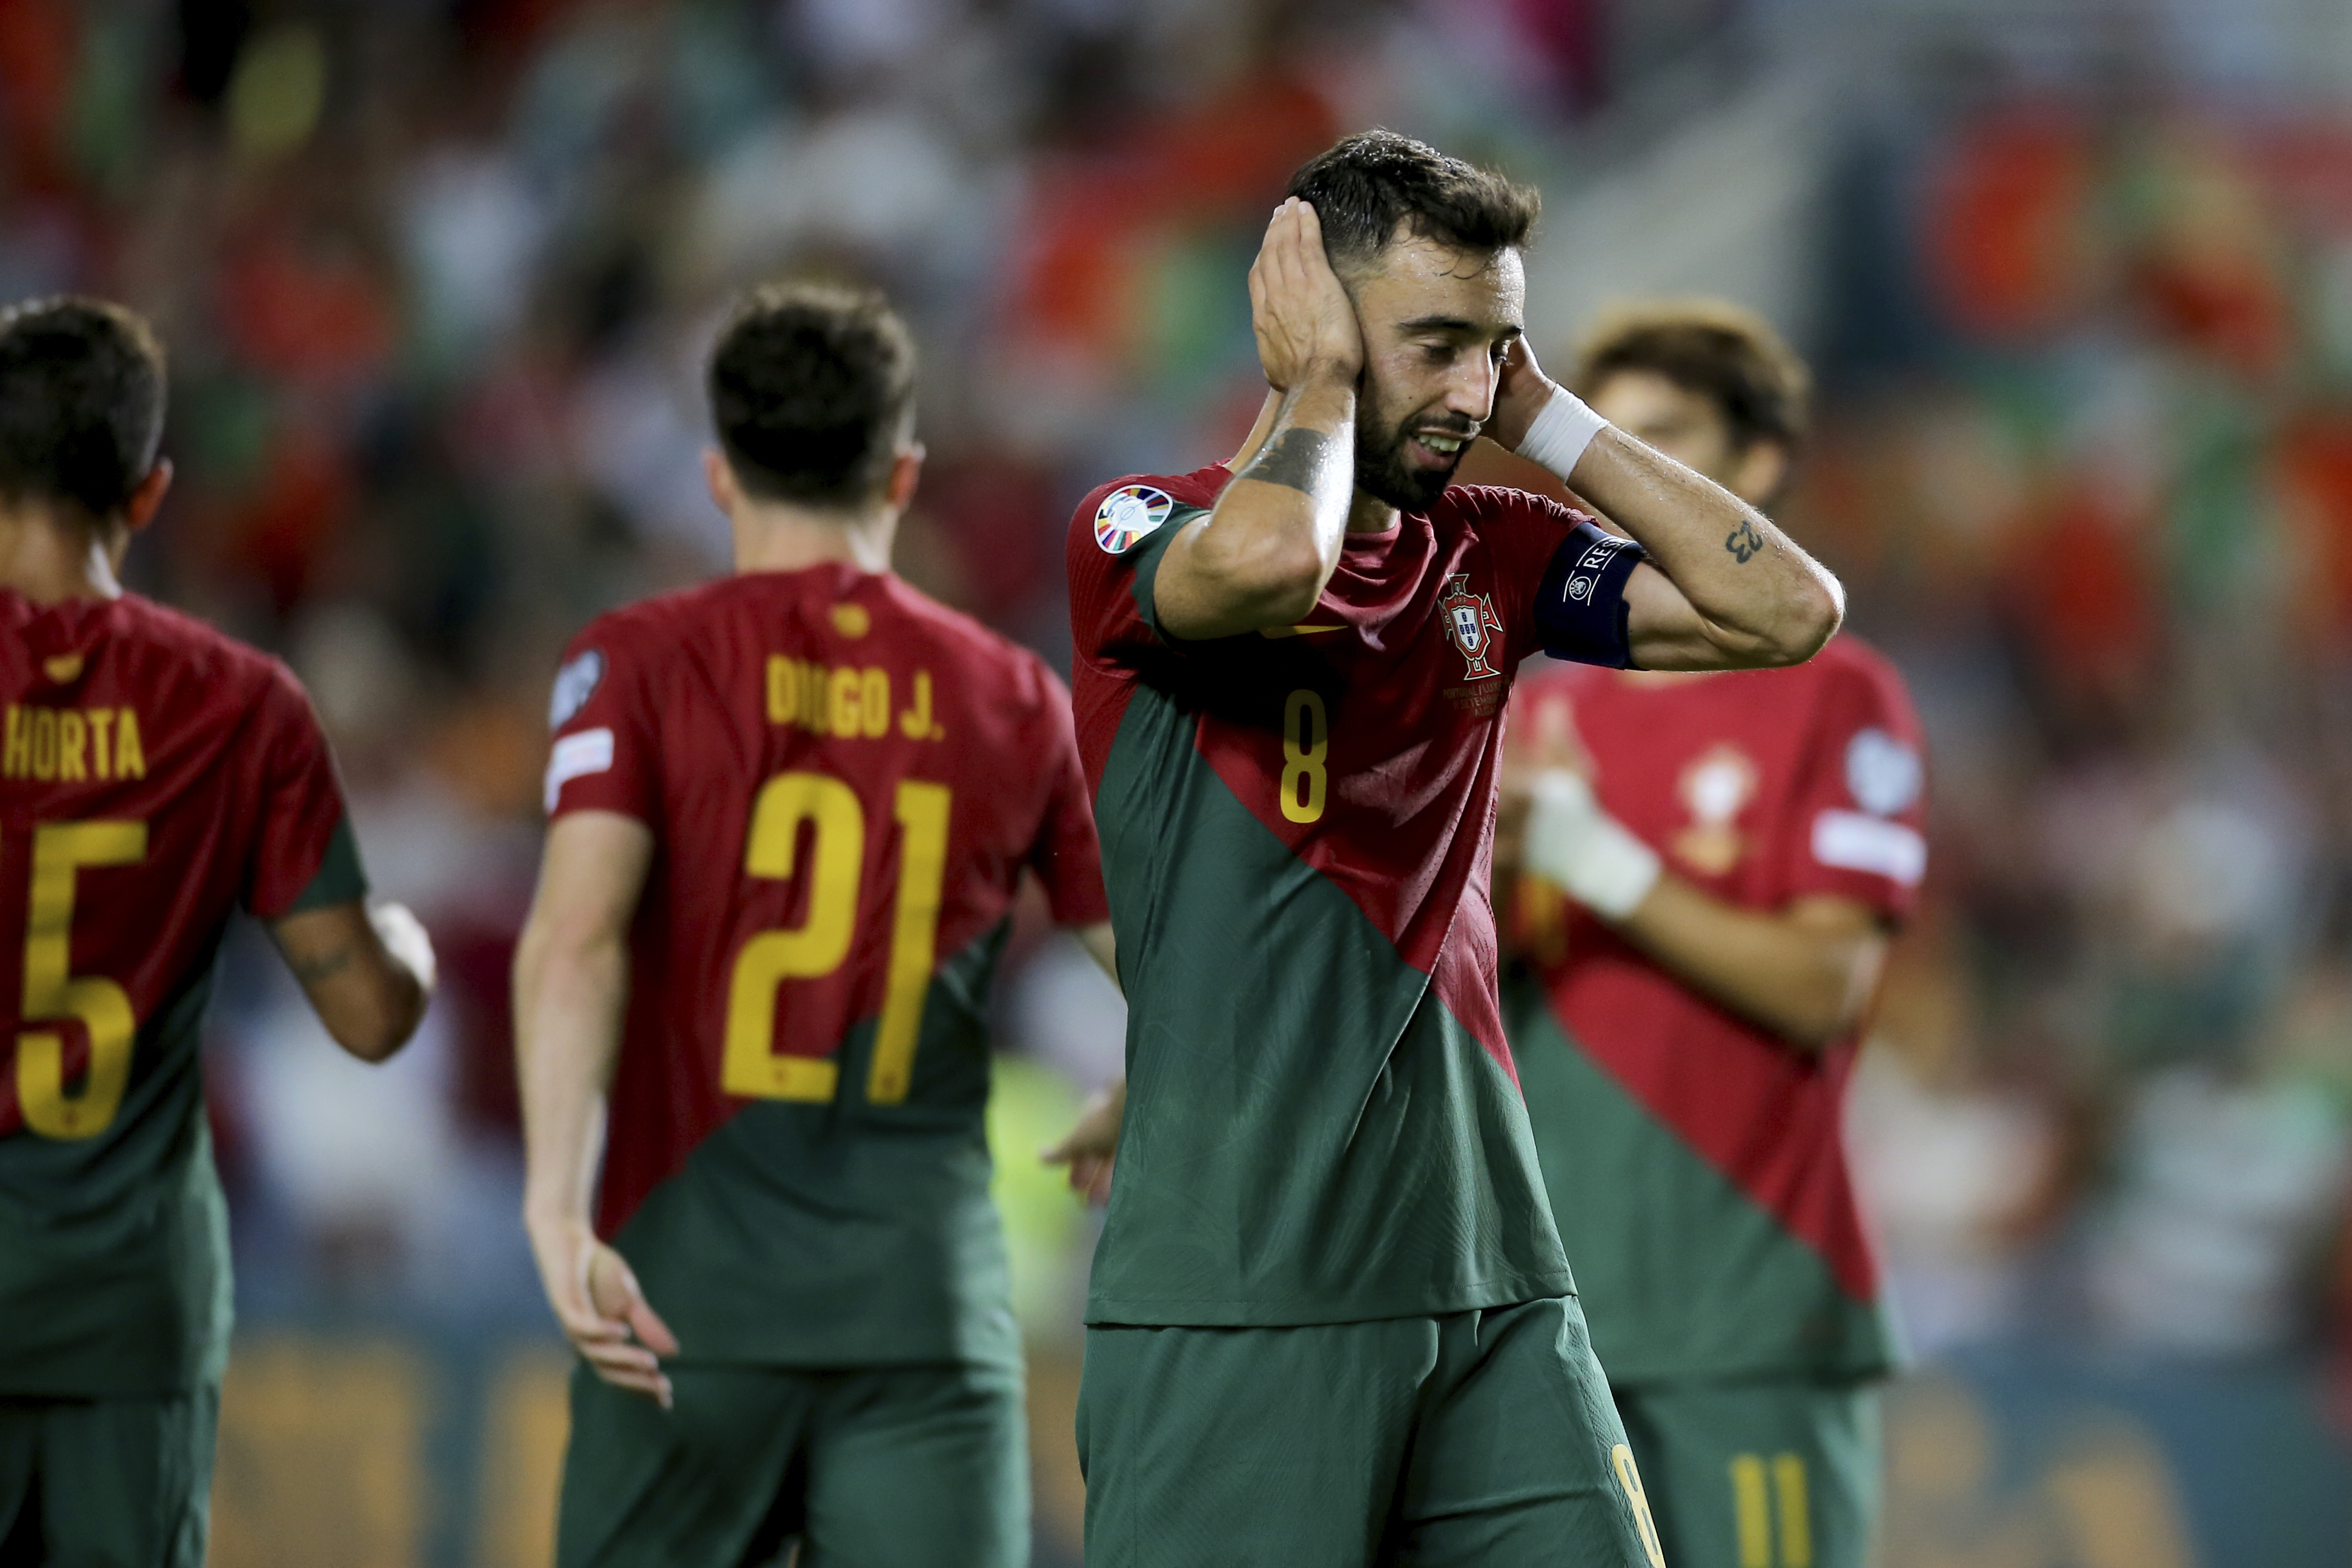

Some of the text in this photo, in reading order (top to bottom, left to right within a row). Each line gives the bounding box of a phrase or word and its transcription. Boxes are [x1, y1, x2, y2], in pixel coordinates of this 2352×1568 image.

[3, 703, 147, 781] HORTA
[899, 667, 946, 743] J.
[1280, 689, 1328, 824] 8
[0, 815, 149, 1140] 5
[721, 771, 952, 1105] 21
[1729, 1452, 1812, 1568] 11
